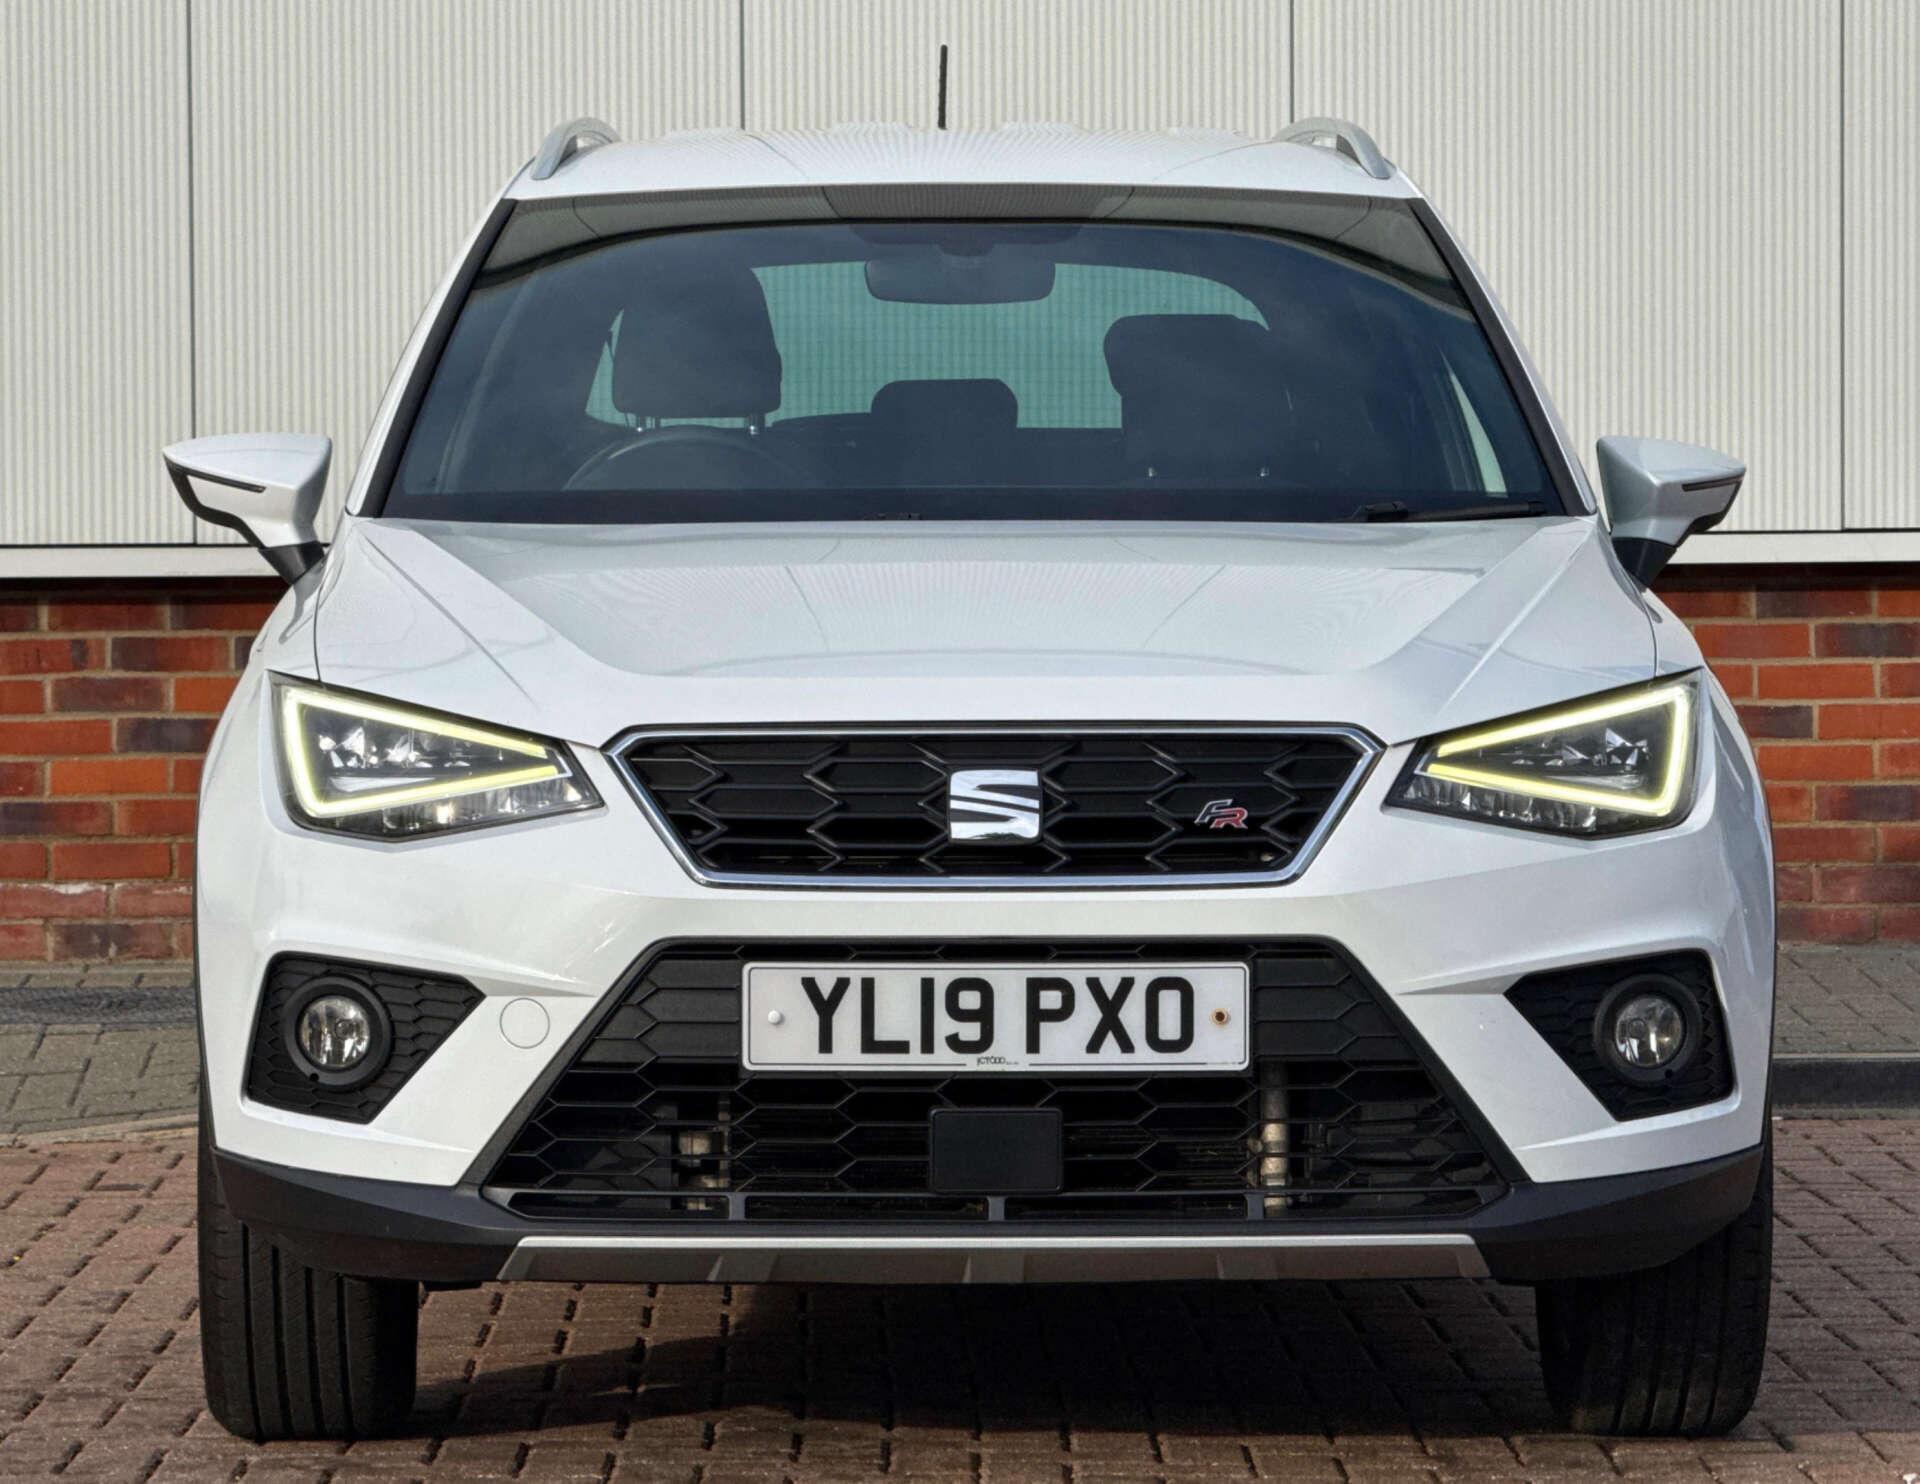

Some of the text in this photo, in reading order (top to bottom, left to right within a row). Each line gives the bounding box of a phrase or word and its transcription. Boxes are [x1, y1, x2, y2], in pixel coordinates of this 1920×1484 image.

[1195, 798, 1248, 829] FR
[801, 977, 1195, 1054] YL19 PXO
